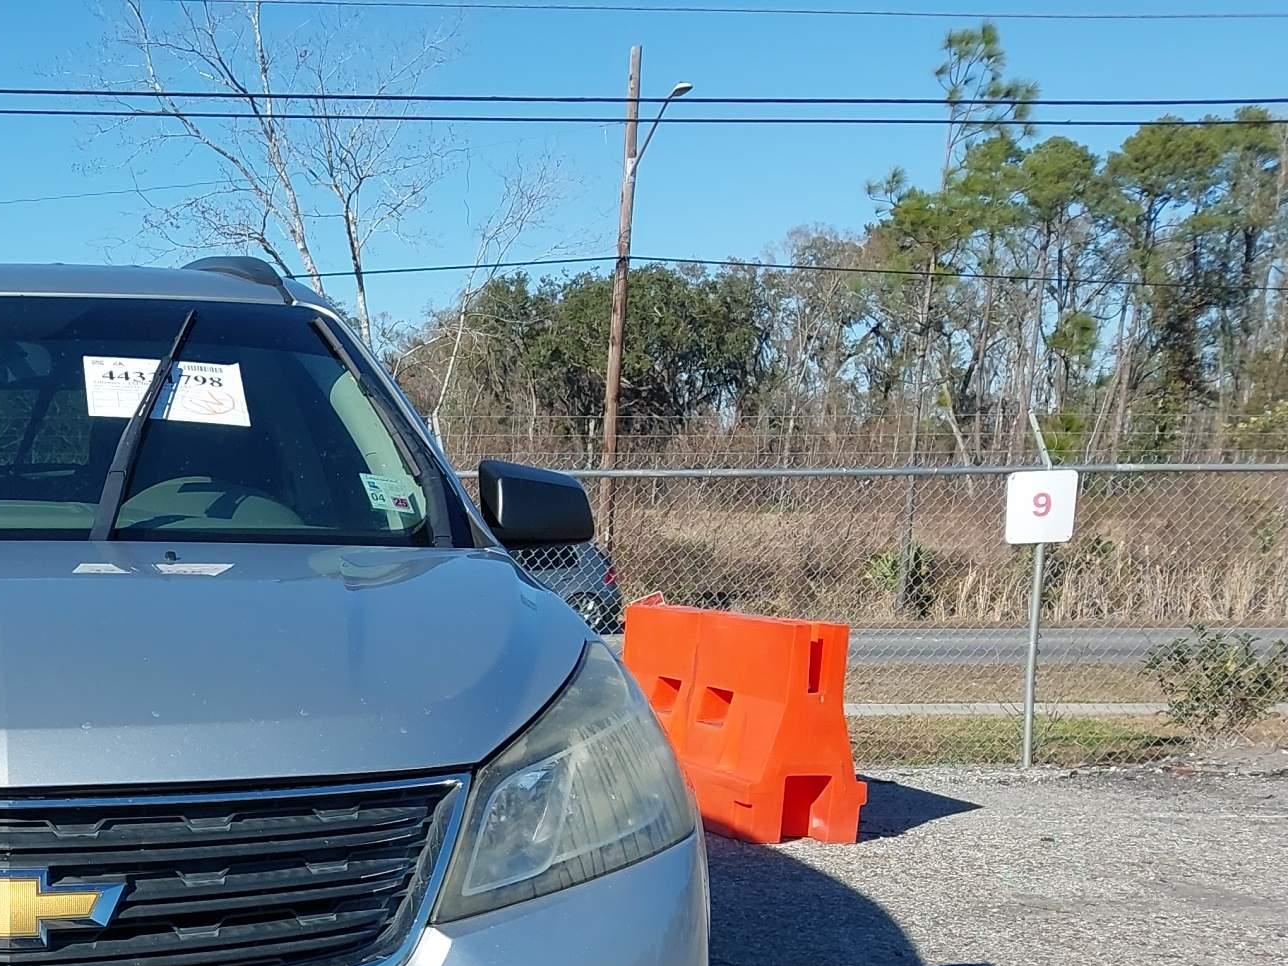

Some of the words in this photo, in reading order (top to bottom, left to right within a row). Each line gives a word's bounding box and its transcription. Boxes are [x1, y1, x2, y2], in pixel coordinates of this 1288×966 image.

[371, 492, 386, 503] 04
[393, 497, 409, 508] 25
[1032, 492, 1052, 517] 9
